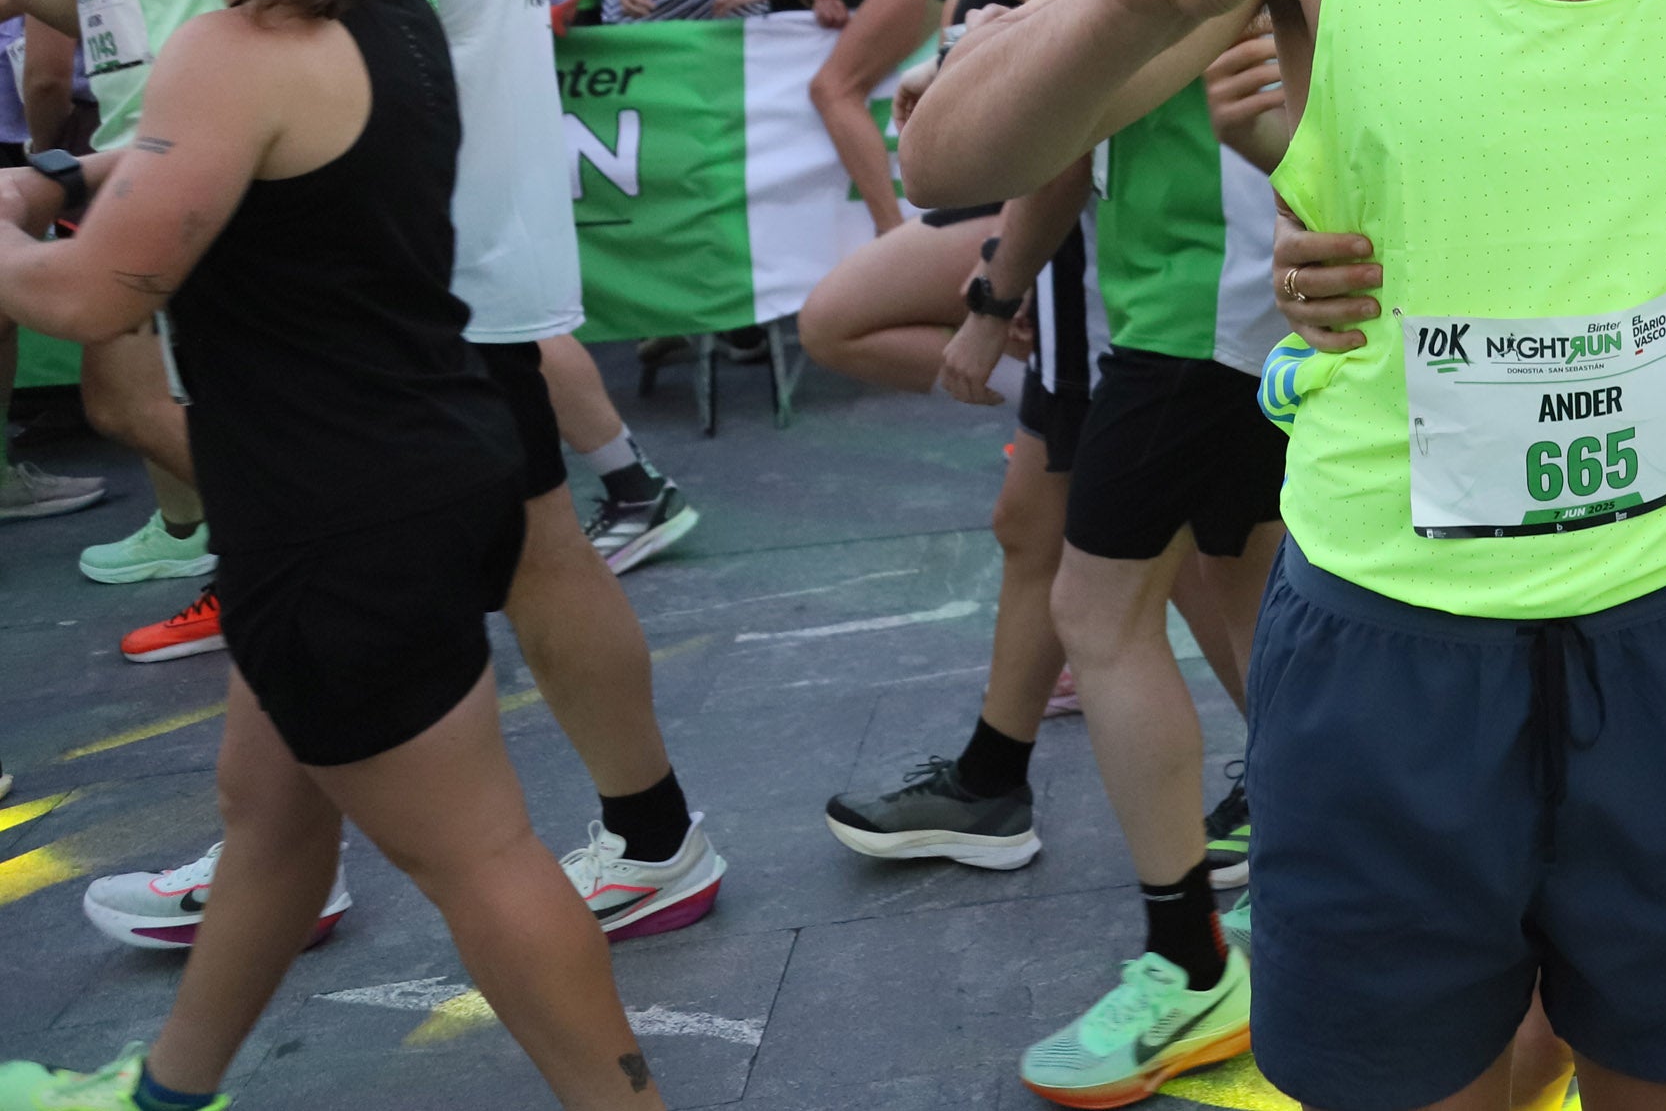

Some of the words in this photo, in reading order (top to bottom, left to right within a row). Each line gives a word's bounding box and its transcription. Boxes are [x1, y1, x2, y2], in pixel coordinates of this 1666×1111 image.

[1587, 321, 1621, 333] Binter
[1632, 315, 1643, 327] EL
[1632, 315, 1666, 338] DIARIO
[1417, 323, 1471, 366] 10K
[1634, 327, 1666, 349] VASCO
[1565, 363, 1605, 373] SEBASTIÁN
[1538, 386, 1623, 423] ANDER
[1526, 427, 1638, 502] 665
[1554, 510, 1560, 520] 7
[1562, 506, 1586, 519] JUN
[1588, 501, 1615, 514] 2025
